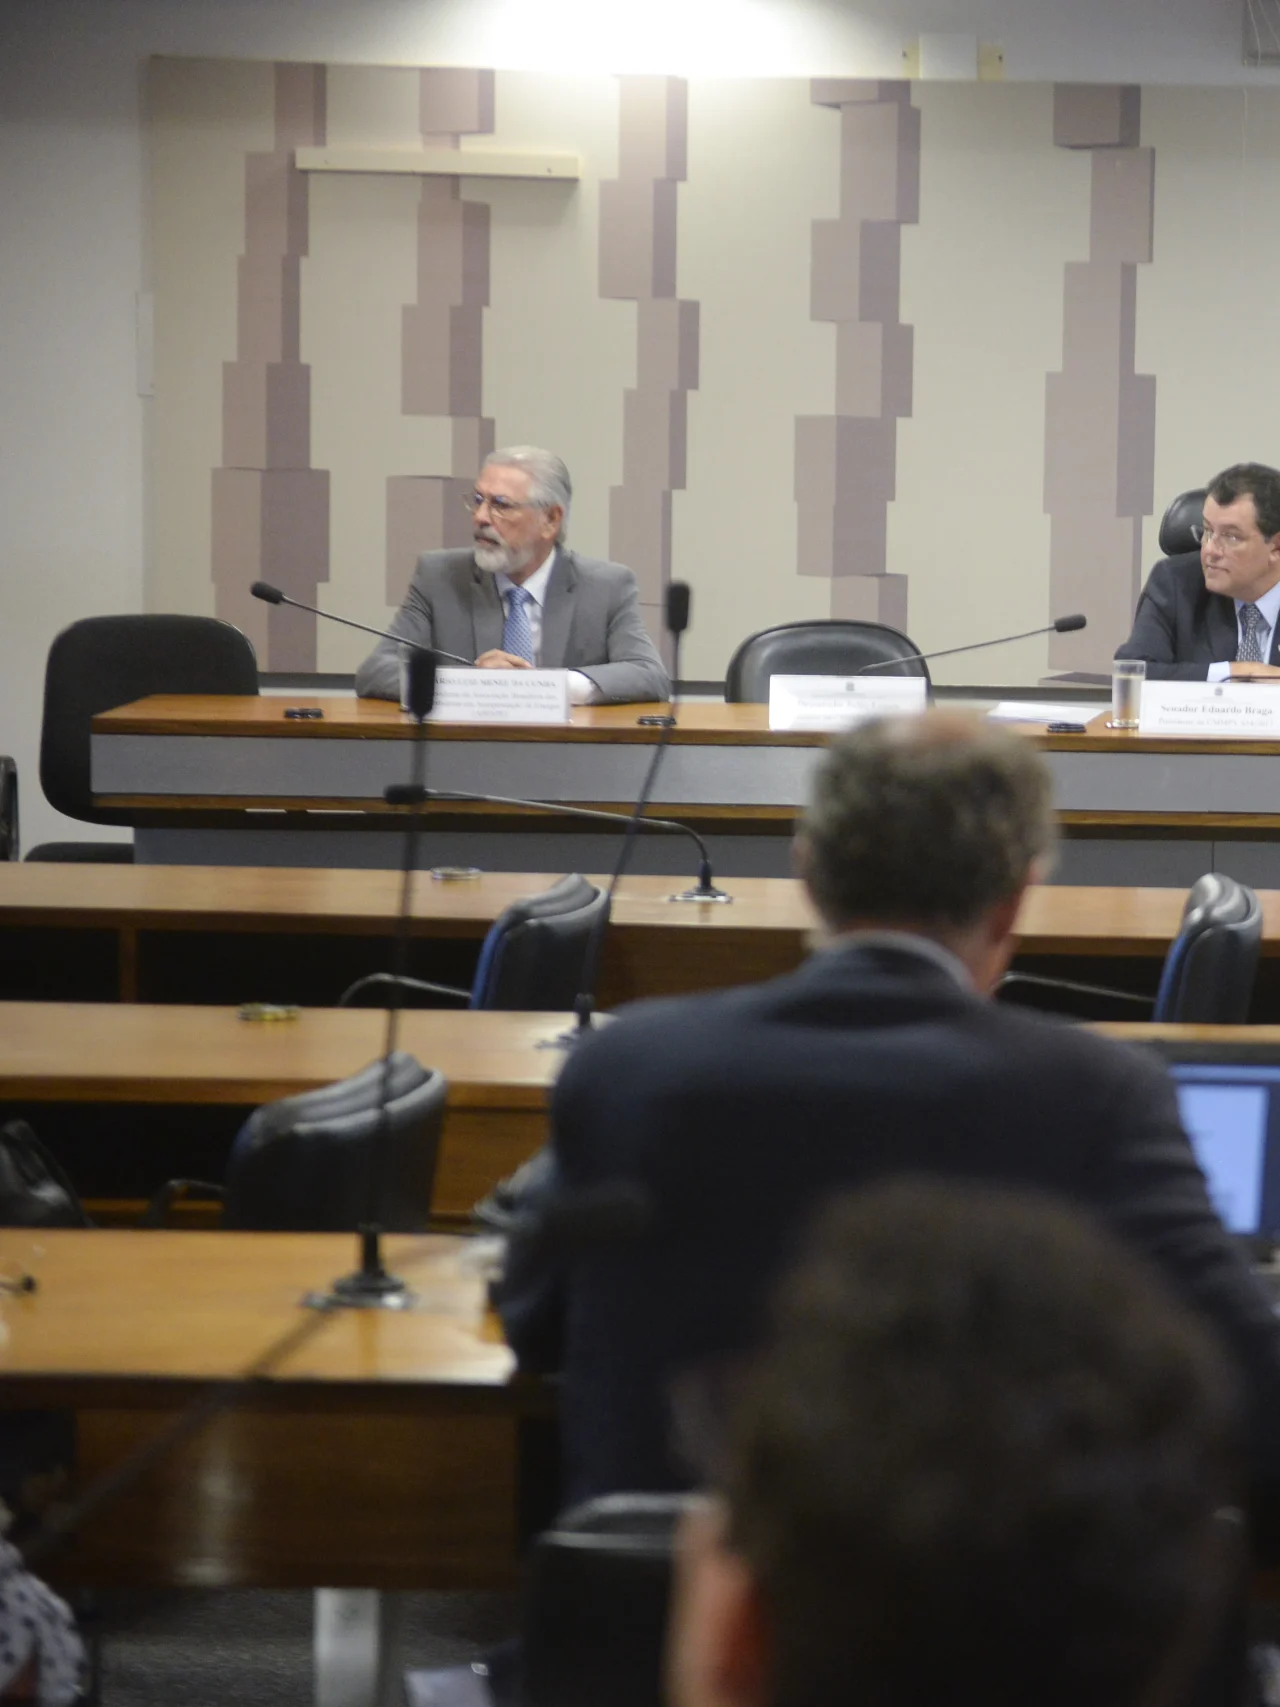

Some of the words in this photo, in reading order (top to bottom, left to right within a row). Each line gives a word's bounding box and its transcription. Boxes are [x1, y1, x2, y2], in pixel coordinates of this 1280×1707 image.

[1160, 704, 1198, 713] Senador
[1202, 706, 1242, 714] Eduardo
[1245, 706, 1274, 716] Braga
